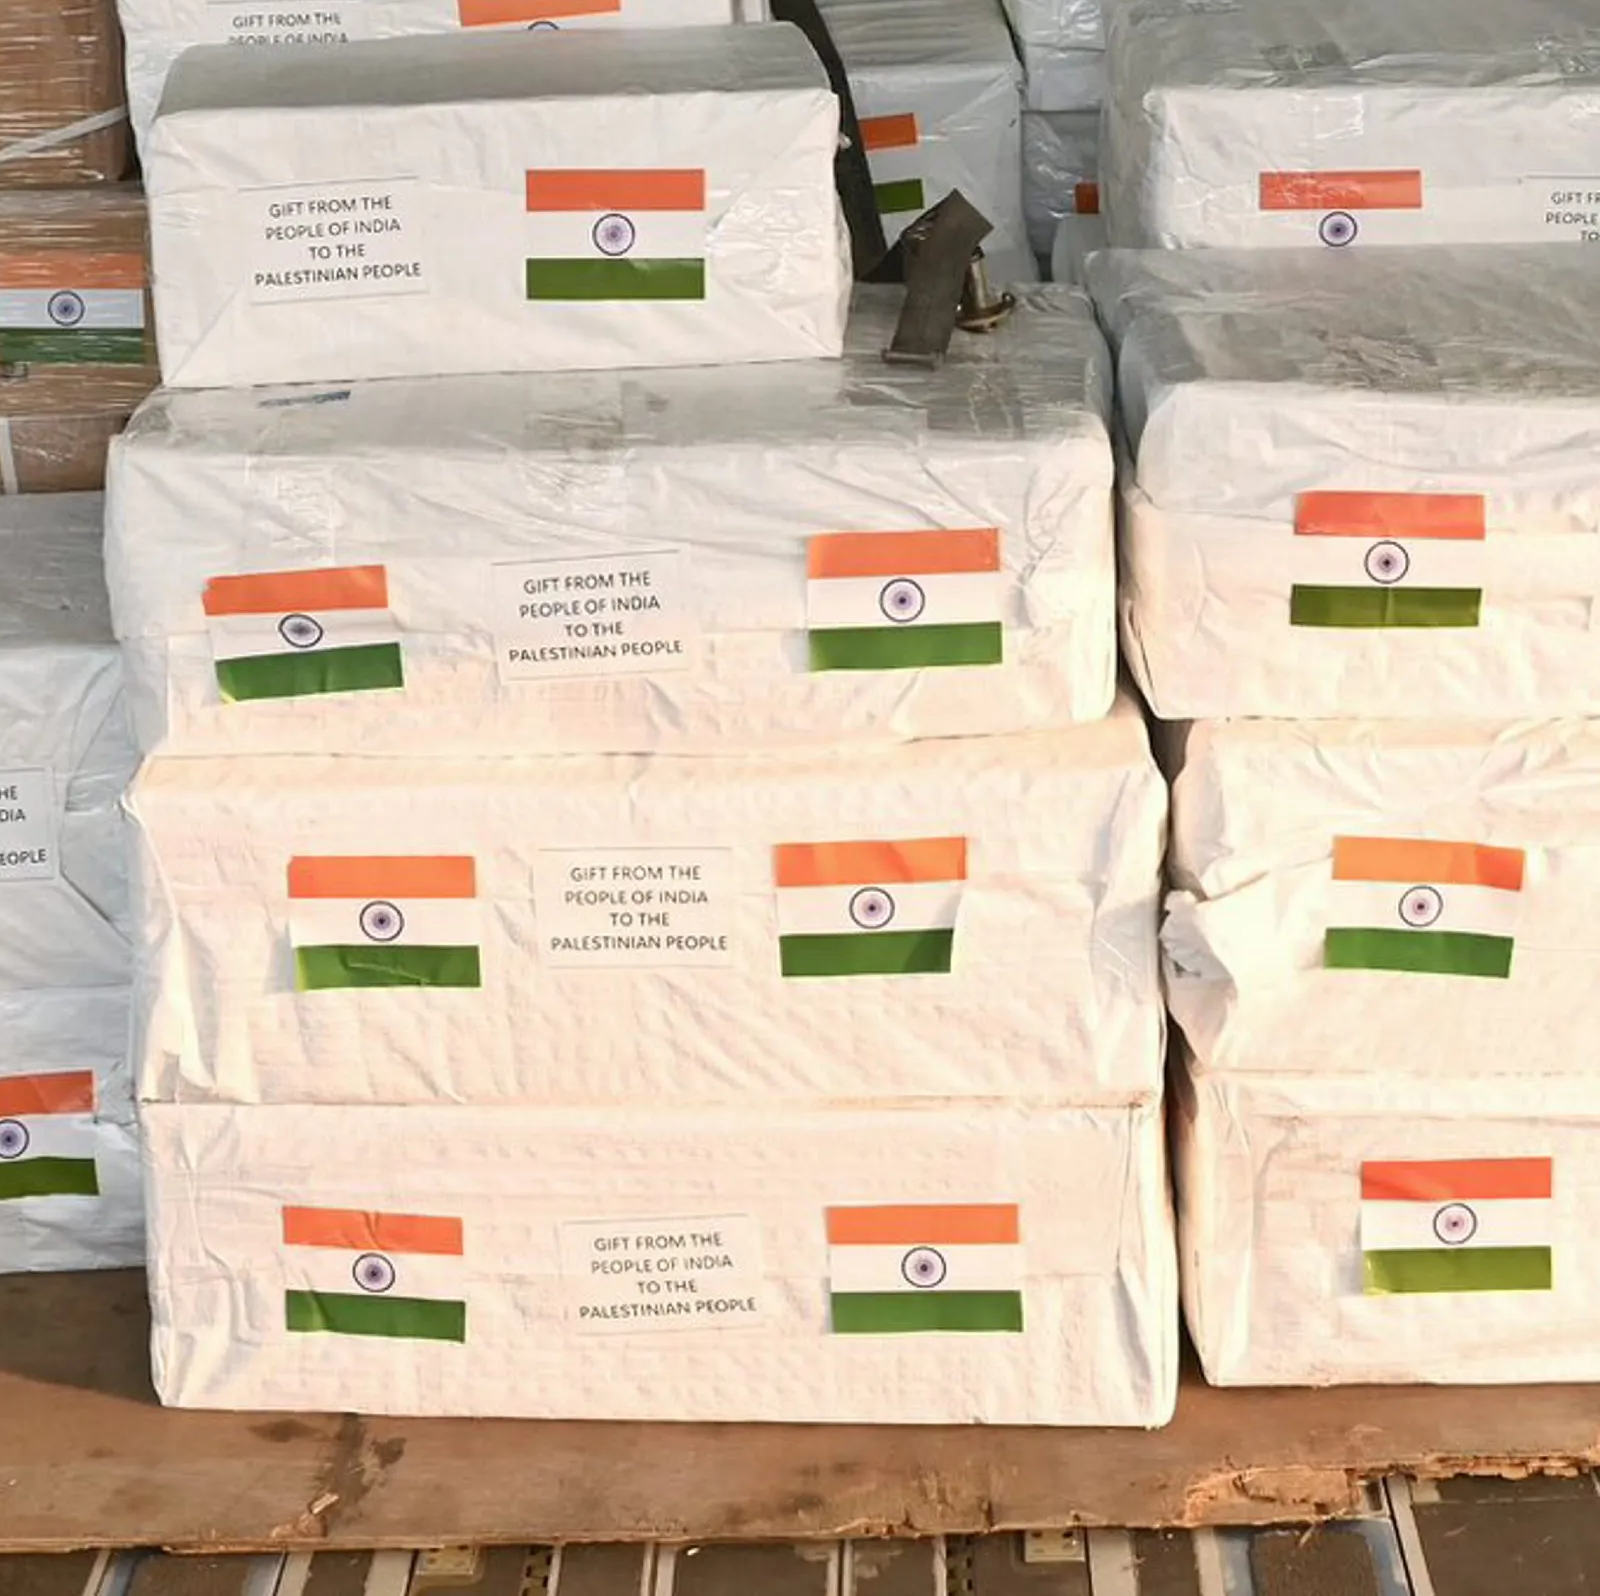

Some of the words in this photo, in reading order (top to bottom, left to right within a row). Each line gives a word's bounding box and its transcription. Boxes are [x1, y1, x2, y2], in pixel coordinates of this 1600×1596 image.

[232, 14, 264, 29] GIFT
[268, 14, 311, 27] FROM
[314, 12, 341, 25] THE
[269, 201, 304, 219] GIFT
[308, 198, 356, 214] FROM
[361, 195, 391, 210] THE
[1551, 192, 1582, 205] GIFT
[1546, 212, 1598, 226] PEOPLE
[266, 223, 324, 240] PEOPLE
[328, 221, 349, 236] OF
[354, 218, 401, 233] INDIA
[309, 245, 331, 260] TO
[336, 243, 364, 258] THE
[254, 267, 358, 286] PALESTINIAN
[362, 262, 420, 279] PEOPLE
[523, 577, 559, 595] GIFT
[564, 574, 614, 590] FROM
[619, 571, 650, 587] THE
[519, 600, 580, 618] PEOPLE
[584, 598, 606, 615] OF
[612, 595, 660, 611] INDIA
[565, 624, 588, 638] TO
[592, 621, 623, 636] THE
[509, 645, 617, 662] PALESTINIAN
[621, 640, 681, 655] PEOPLE
[570, 867, 606, 882] GIFT
[612, 865, 663, 880] FROM
[669, 865, 701, 880] THE
[565, 890, 627, 905] PEOPLE
[631, 890, 653, 904] OF
[659, 890, 708, 904] INDIA
[610, 912, 633, 927] TO
[639, 912, 669, 927] THE
[551, 936, 661, 950] PALESTINIAN
[666, 935, 726, 951] PEOPLE
[594, 1237, 629, 1251] GIFT
[636, 1235, 686, 1249] FROM
[690, 1232, 722, 1247] THE
[592, 1259, 652, 1274] PEOPLE
[656, 1257, 677, 1272] OF
[685, 1255, 733, 1270] INDIA
[637, 1280, 661, 1294] TO
[664, 1279, 697, 1293] THE
[579, 1301, 691, 1319] PALESTINIAN
[695, 1297, 756, 1314] PEOPLE
